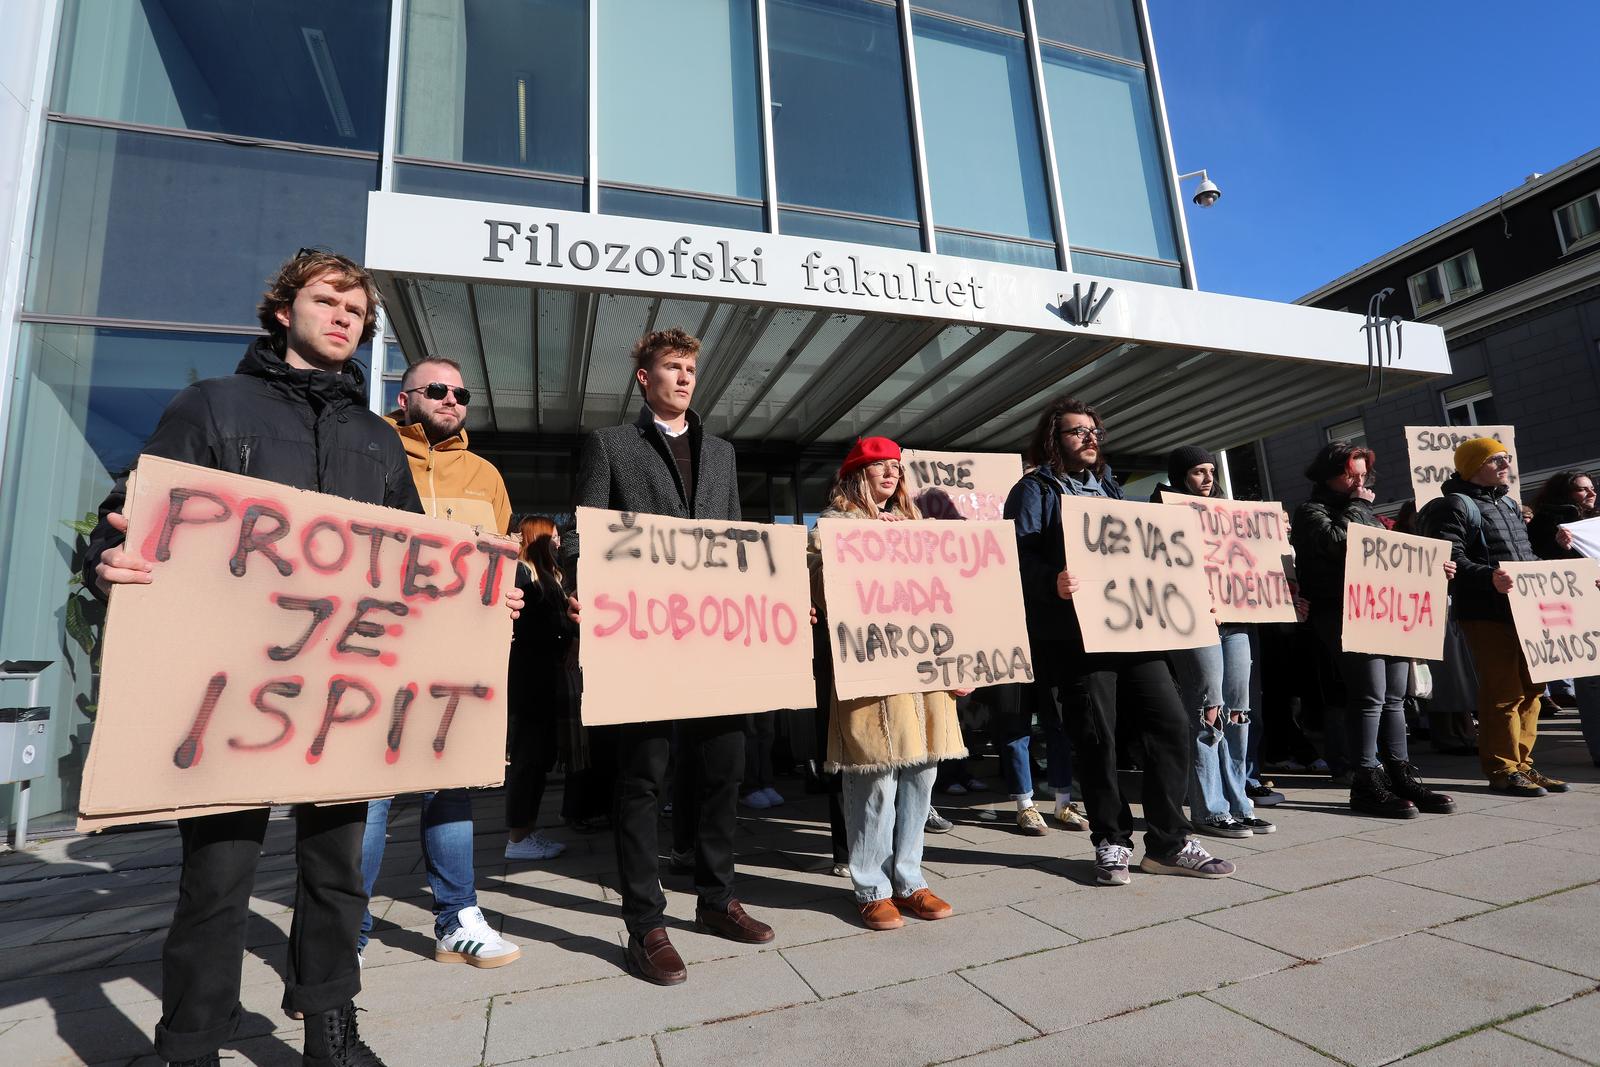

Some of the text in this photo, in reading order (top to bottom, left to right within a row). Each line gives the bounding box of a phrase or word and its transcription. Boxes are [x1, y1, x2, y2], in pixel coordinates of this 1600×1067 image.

[482, 219, 985, 309] Filozofski fakultet
[1417, 431, 1502, 452] SLOB
[909, 460, 974, 490] NIJE
[1134, 517, 1194, 567] VAS
[1180, 501, 1282, 541] TUDENTI
[143, 487, 519, 606] PROTEST
[835, 528, 1006, 577] KORUPCIJA
[1203, 539, 1256, 570] ZA
[1362, 537, 1437, 577] PROTIV
[855, 576, 954, 616] VLADA
[1103, 577, 1196, 636] SMO
[1516, 570, 1584, 598] OTPOR
[593, 589, 798, 647] SLOBODNO
[1347, 583, 1433, 632] NASILJA
[267, 595, 410, 667] JE
[837, 621, 955, 663] NAROD
[916, 646, 1035, 687] STRADA
[172, 671, 494, 769] ISPIT
